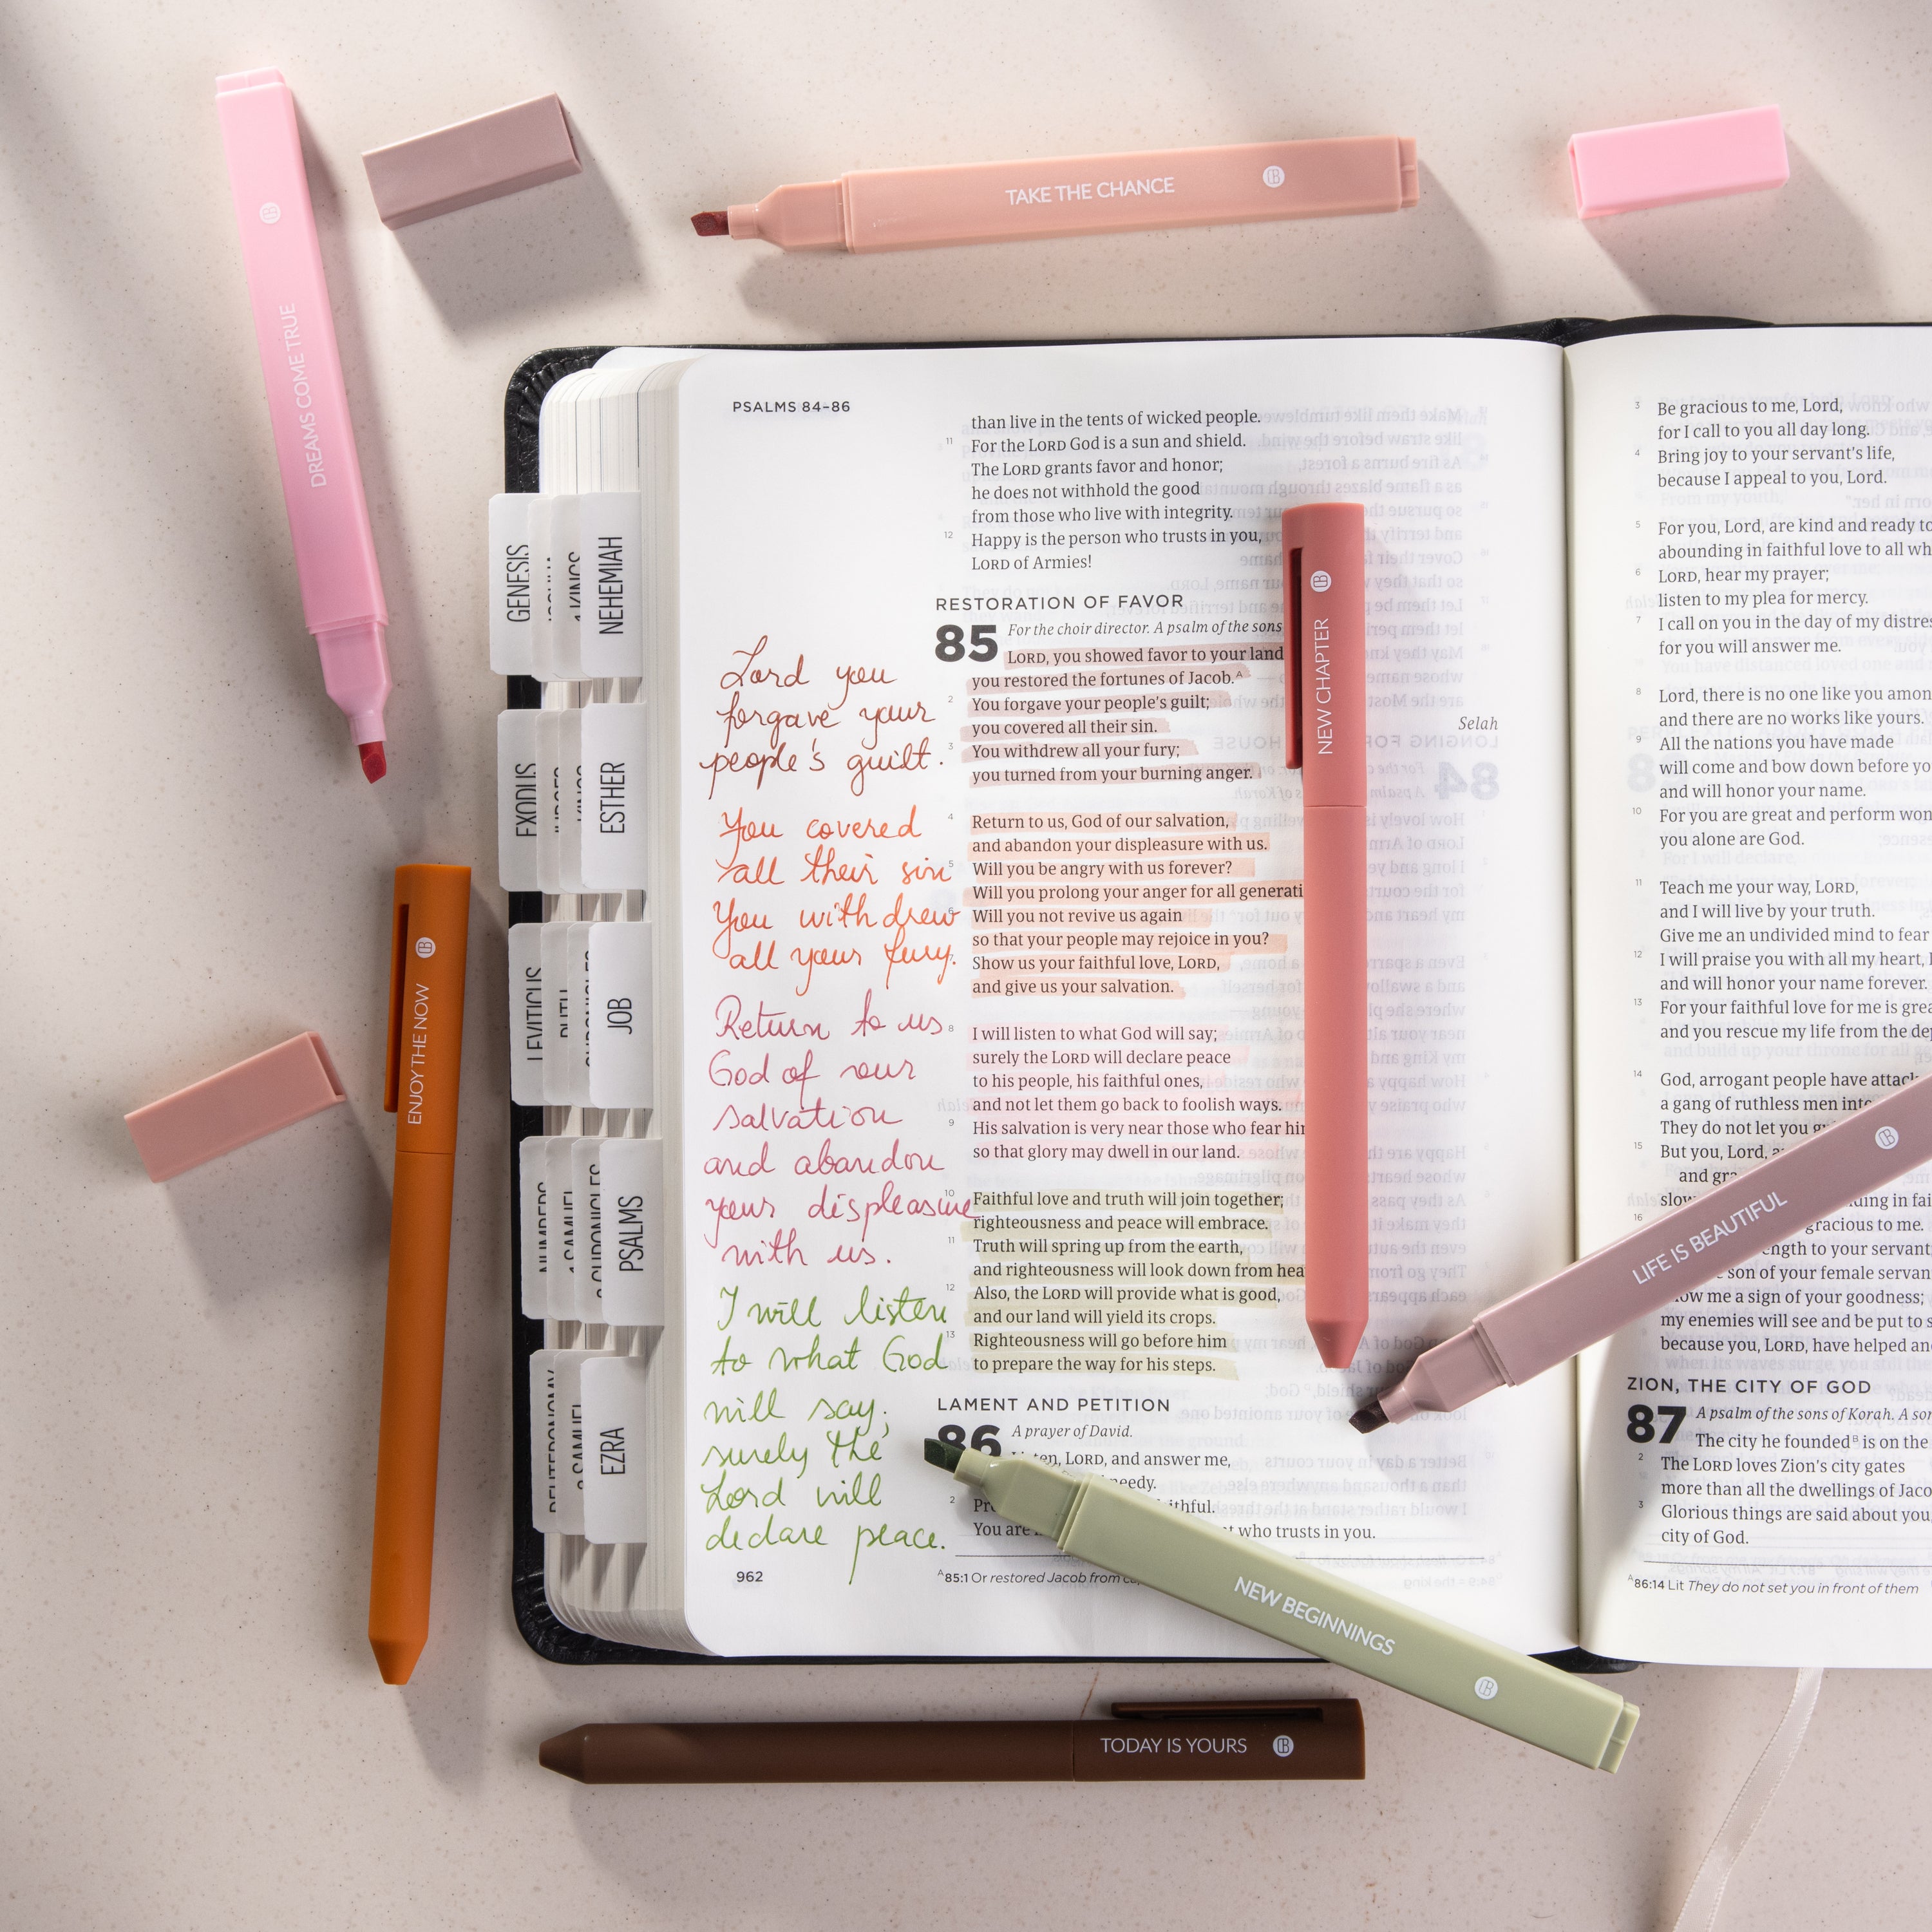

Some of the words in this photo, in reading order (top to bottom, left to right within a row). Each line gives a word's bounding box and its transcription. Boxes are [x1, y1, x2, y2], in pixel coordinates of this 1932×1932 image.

[1005, 186, 1052, 205] TAKE
[1054, 183, 1093, 201] THE
[1096, 176, 1175, 198] CHANCE
[279, 303, 300, 352] TRUE
[289, 352, 312, 410] COME
[733, 401, 797, 413] PSALMS
[972, 415, 1006, 430] than
[1010, 415, 1037, 429] live
[1041, 414, 1056, 428] in
[1059, 413, 1083, 428] the
[1086, 413, 1124, 426] tents
[1128, 410, 1144, 425] of
[1146, 410, 1202, 424] wicked
[1205, 409, 1261, 427] people.
[1634, 401, 1641, 410] 3
[299, 412, 327, 488] DREAMS
[506, 544, 530, 623] GENESIS
[598, 536, 624, 634] NEHEMIAH
[936, 596, 1074, 611] RESTORATION
[1084, 595, 1110, 609] OF
[1119, 594, 1183, 608] FAVOR
[1658, 593, 1701, 607] listen
[1705, 594, 1720, 606] to
[1725, 594, 1749, 608] my
[1752, 592, 1786, 609] plea
[1790, 590, 1814, 604] for
[1817, 593, 1868, 607] mercy.
[935, 624, 998, 663] 85
[1314, 618, 1332, 704] CHAPTER
[721, 636, 810, 690] Lord
[828, 665, 898, 710] you
[717, 690, 841, 748] forgave
[860, 701, 936, 750] your
[1316, 708, 1333, 755] NEW
[1458, 716, 1497, 730] Selah
[1659, 736, 1681, 751] All
[1685, 736, 1709, 750] the
[1713, 735, 1772, 750] nations
[1776, 738, 1805, 752] you
[1810, 735, 1846, 749] have
[1850, 734, 1894, 748] made
[600, 762, 625, 833] ESTHER
[715, 807, 784, 869] You
[806, 804, 922, 838] covered
[972, 838, 1001, 852] and
[1005, 838, 1072, 852] abandon
[1075, 840, 1112, 855] your
[1115, 837, 1204, 855] displeasure
[1207, 836, 1243, 851] with
[1246, 839, 1267, 850] us.
[718, 856, 784, 884] all
[800, 844, 878, 885] their
[902, 858, 951, 884] sin
[730, 941, 779, 971] all
[791, 945, 862, 996] your
[1660, 976, 1689, 990] and
[1692, 976, 1722, 990] will
[1726, 976, 1776, 990] honor
[1779, 979, 1816, 993] your
[1819, 979, 1864, 990] name
[1868, 975, 1927, 990] forever.
[413, 983, 430, 1030] NOW
[607, 998, 632, 1035] JOB
[715, 994, 829, 1040] Return
[851, 989, 886, 1036] to
[898, 1013, 942, 1034] us
[411, 1034, 427, 1066] THE
[408, 1069, 424, 1125] ENJOY
[709, 1050, 769, 1086] God
[782, 1049, 820, 1110] of
[840, 1059, 916, 1080] our
[713, 1097, 903, 1131] salvation
[703, 1141, 775, 1176] and
[794, 1138, 945, 1175] abandon
[973, 1148, 990, 1158] so
[994, 1144, 1024, 1158] that
[1028, 1144, 1068, 1161] glory
[1071, 1148, 1104, 1161] may
[1108, 1144, 1149, 1159] dwell
[1153, 1144, 1168, 1159] in
[1172, 1148, 1199, 1159] our
[1202, 1144, 1240, 1159] land.
[618, 1195, 644, 1271] PSALMS
[704, 1197, 775, 1248] your
[1631, 1253, 1672, 1285] LIFE
[1671, 1244, 1690, 1264] IS
[1689, 1191, 1788, 1253] BEAUTIFUL
[721, 1227, 808, 1266] with
[717, 1285, 739, 1331] I
[747, 1296, 822, 1327] will
[844, 1285, 947, 1327] listen
[711, 1336, 753, 1376] to
[769, 1334, 862, 1372] what
[882, 1332, 949, 1372] God
[973, 1358, 989, 1370] to
[992, 1359, 1053, 1374] prepare
[1057, 1356, 1081, 1370] the
[1084, 1359, 1117, 1374] way
[1120, 1356, 1143, 1371] for
[1146, 1357, 1169, 1371] his
[1173, 1359, 1216, 1375] steps.
[938, 1397, 1018, 1411] LAMENT
[1027, 1398, 1069, 1411] AND
[1078, 1398, 1170, 1412] PETITION
[1627, 1376, 1680, 1394] ZION,
[1687, 1379, 1727, 1393] THE
[1735, 1379, 1782, 1394] CITY
[1790, 1380, 1817, 1394] OF
[1826, 1380, 1871, 1394] GOD
[703, 1387, 786, 1424] will
[1626, 1404, 1687, 1444] 87
[600, 1427, 625, 1475] EZRA
[701, 1432, 808, 1478] surely
[827, 1426, 882, 1468] the
[701, 1470, 786, 1513] Lord
[817, 1471, 882, 1508] will
[1662, 1528, 1690, 1546] city
[1694, 1529, 1710, 1544] of
[1713, 1530, 1748, 1544] God.
[736, 1571, 763, 1583] 962
[1668, 1580, 1684, 1591] Lit
[1689, 1580, 1719, 1594] They
[1721, 1581, 1739, 1593] do
[1742, 1582, 1765, 1593] not
[1767, 1583, 1788, 1593] set
[1789, 1584, 1815, 1595] you
[1817, 1582, 1829, 1594] in
[1832, 1582, 1866, 1594] front
[1868, 1582, 1883, 1594] of
[1884, 1583, 1918, 1594] them
[1234, 1576, 1283, 1607] NEW
[1282, 1596, 1396, 1656] BEGINNINGS
[1100, 1738, 1162, 1753] TODAY
[1167, 1738, 1182, 1753] IS
[1186, 1738, 1247, 1753] YOURS
